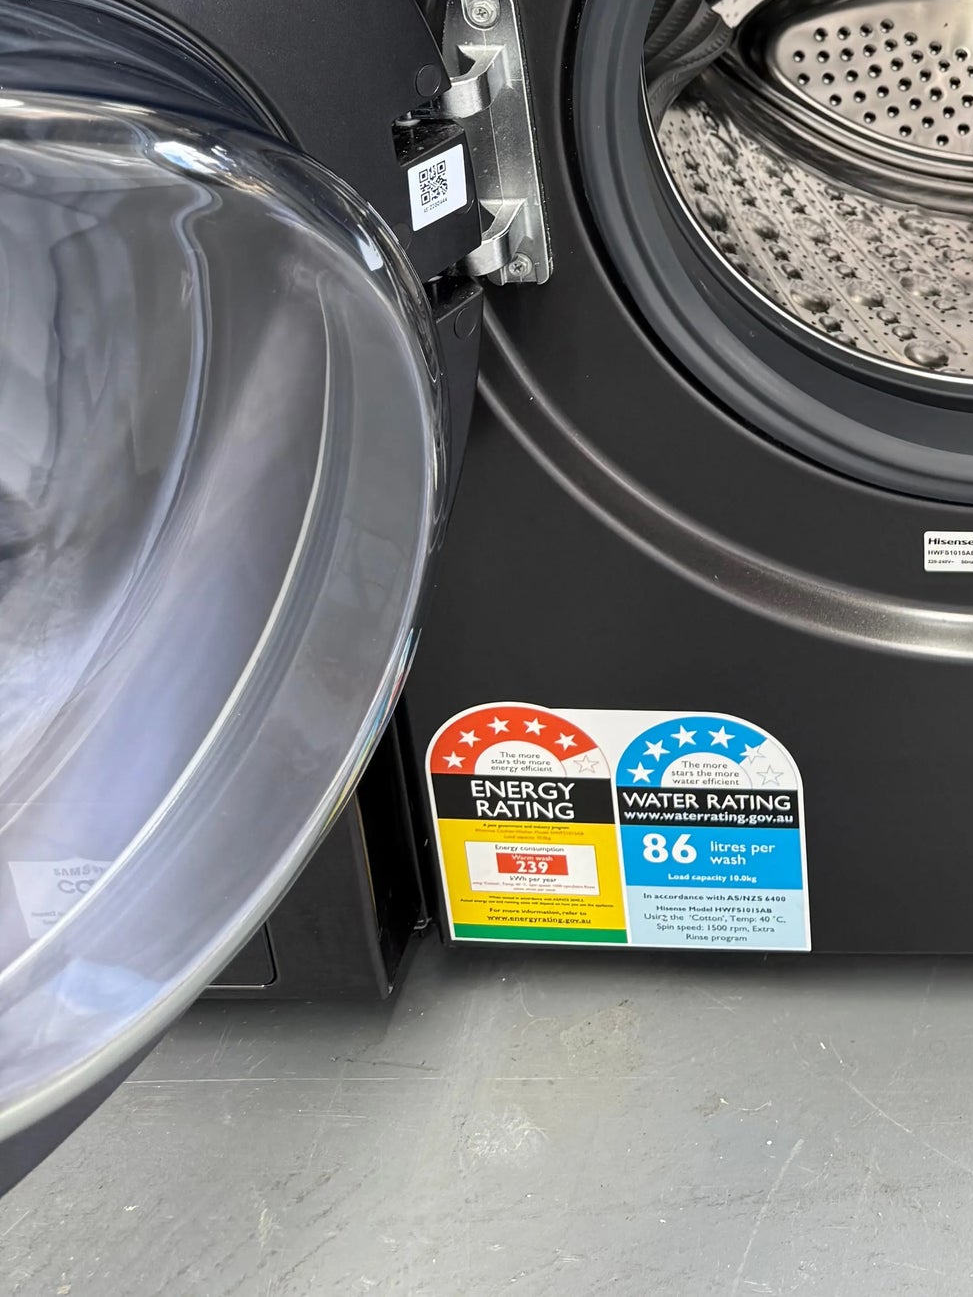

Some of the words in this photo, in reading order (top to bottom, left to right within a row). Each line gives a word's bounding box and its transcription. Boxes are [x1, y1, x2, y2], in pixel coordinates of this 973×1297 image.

[490, 765, 518, 773] energy
[681, 760, 700, 768] The
[470, 779, 575, 801] ENERGY
[623, 792, 700, 810] WATER
[707, 794, 791, 811] RATING
[475, 800, 575, 820] RATING
[624, 810, 794, 824] www.waterrating.gov.au
[495, 844, 518, 852] Energy
[642, 833, 697, 864] 86
[710, 841, 746, 853] litres
[751, 843, 776, 856] per
[710, 854, 746, 865] wash
[515, 860, 549, 873] 239
[668, 873, 690, 881] Load
[691, 874, 727, 882] capacity
[654, 893, 704, 901] accordance
[487, 915, 591, 924] www.energyrating.gov.au
[656, 923, 674, 931] Spin
[685, 933, 709, 941] Rinse
[711, 935, 748, 943] program
